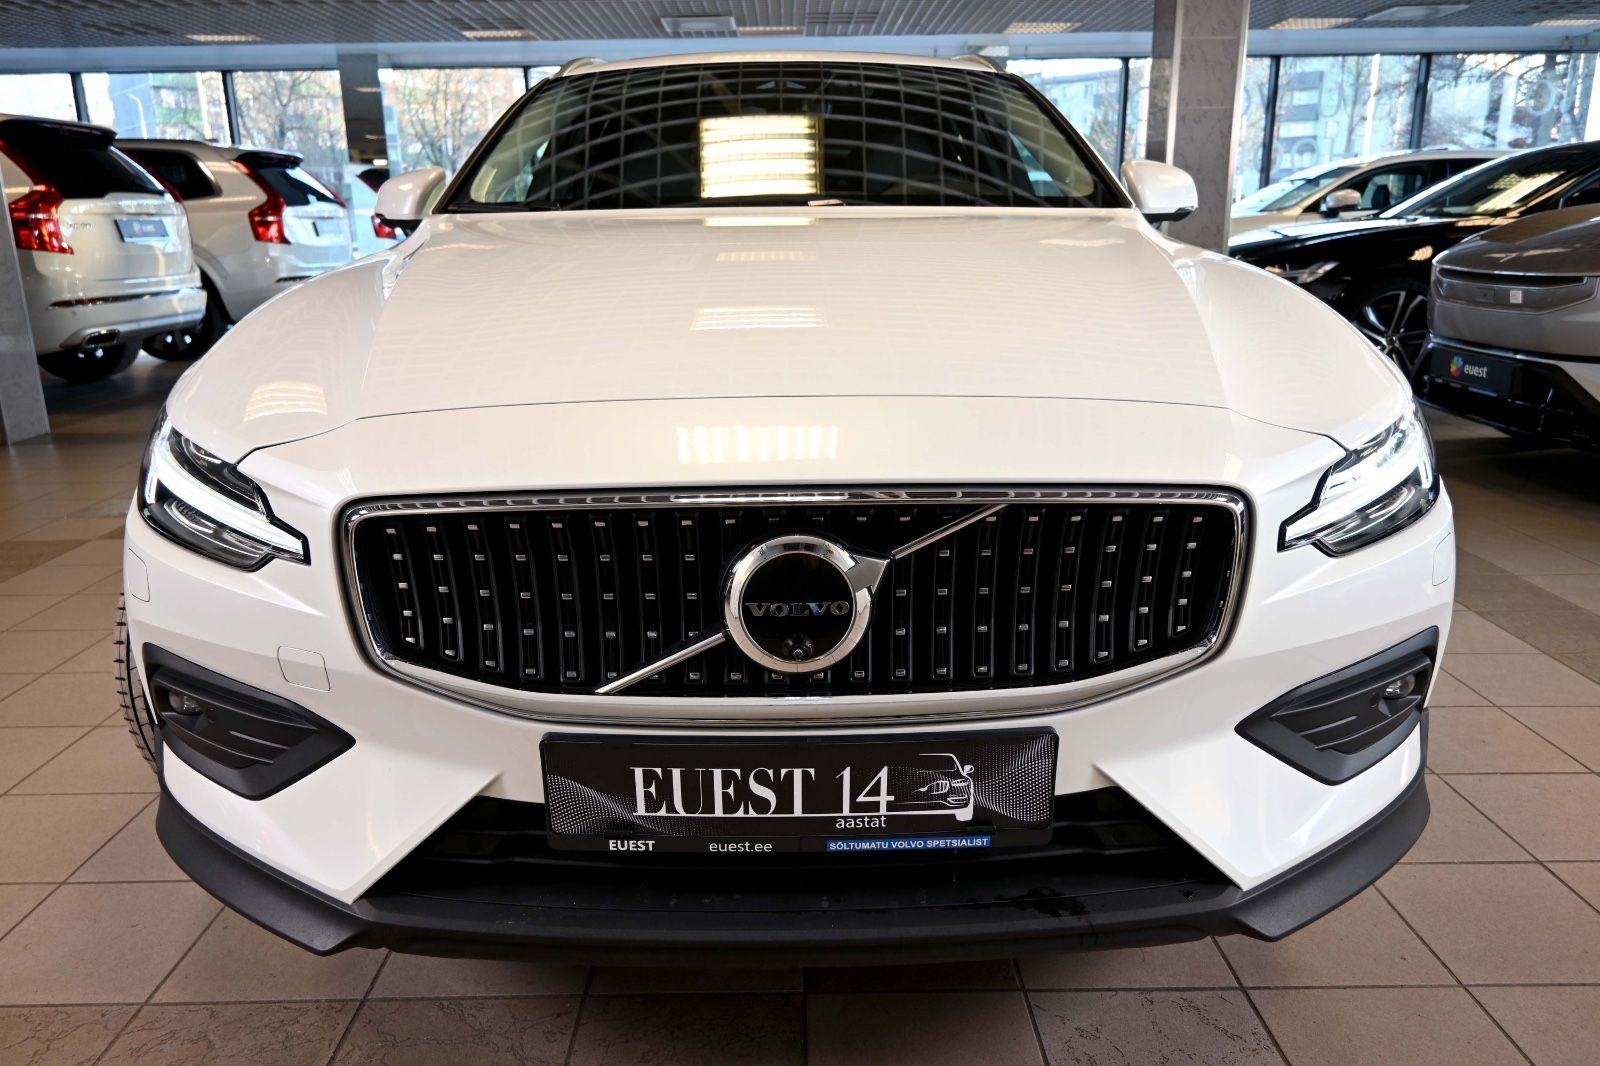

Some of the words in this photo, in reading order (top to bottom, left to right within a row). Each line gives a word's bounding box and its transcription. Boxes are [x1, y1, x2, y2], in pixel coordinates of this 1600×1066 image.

[1464, 363, 1488, 379] euest
[745, 601, 850, 617] VOLVO
[629, 766, 816, 817] EUEST
[835, 765, 895, 816] 14
[836, 815, 887, 829] aastat
[608, 839, 656, 852] EUEST
[709, 841, 773, 853] euest.ee
[829, 840, 889, 850] SÕLTUMATU
[890, 840, 925, 849] VOLVO
[926, 838, 989, 848] SPETSIALIST
